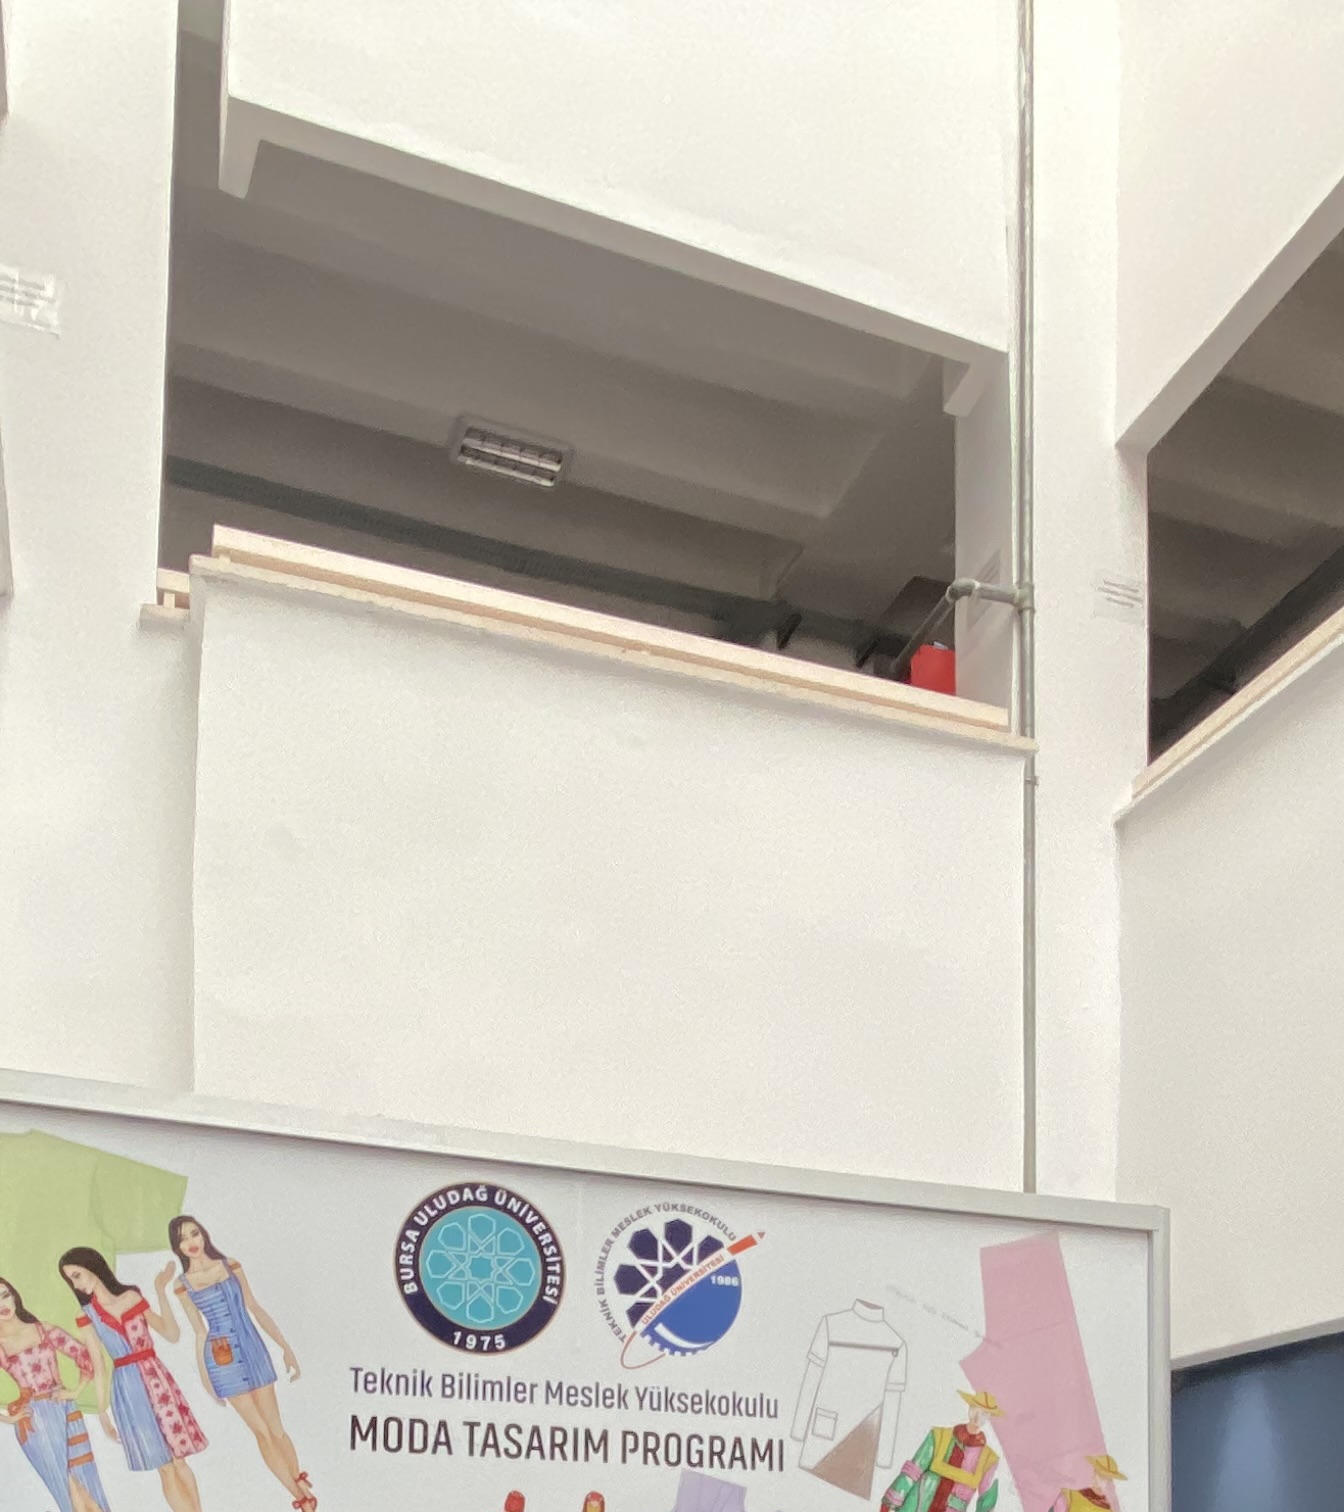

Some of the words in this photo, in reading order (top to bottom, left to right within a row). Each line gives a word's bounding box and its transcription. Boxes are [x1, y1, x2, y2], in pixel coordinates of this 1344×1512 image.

[399, 1229, 420, 1294] BURSA
[414, 1185, 489, 1226] ULUDAĞ
[611, 1206, 653, 1239] MESLEK
[654, 1202, 737, 1242] YÜKSEKOKULU
[453, 1331, 506, 1351] 1975
[350, 1367, 433, 1398] Teknik
[441, 1372, 538, 1404] Bilimler
[545, 1379, 629, 1410] Meslek
[635, 1386, 778, 1419] Yüksekokulu
[350, 1414, 453, 1455] MODA
[462, 1420, 609, 1463] TASARIM
[621, 1430, 784, 1472] PROGRAMI
